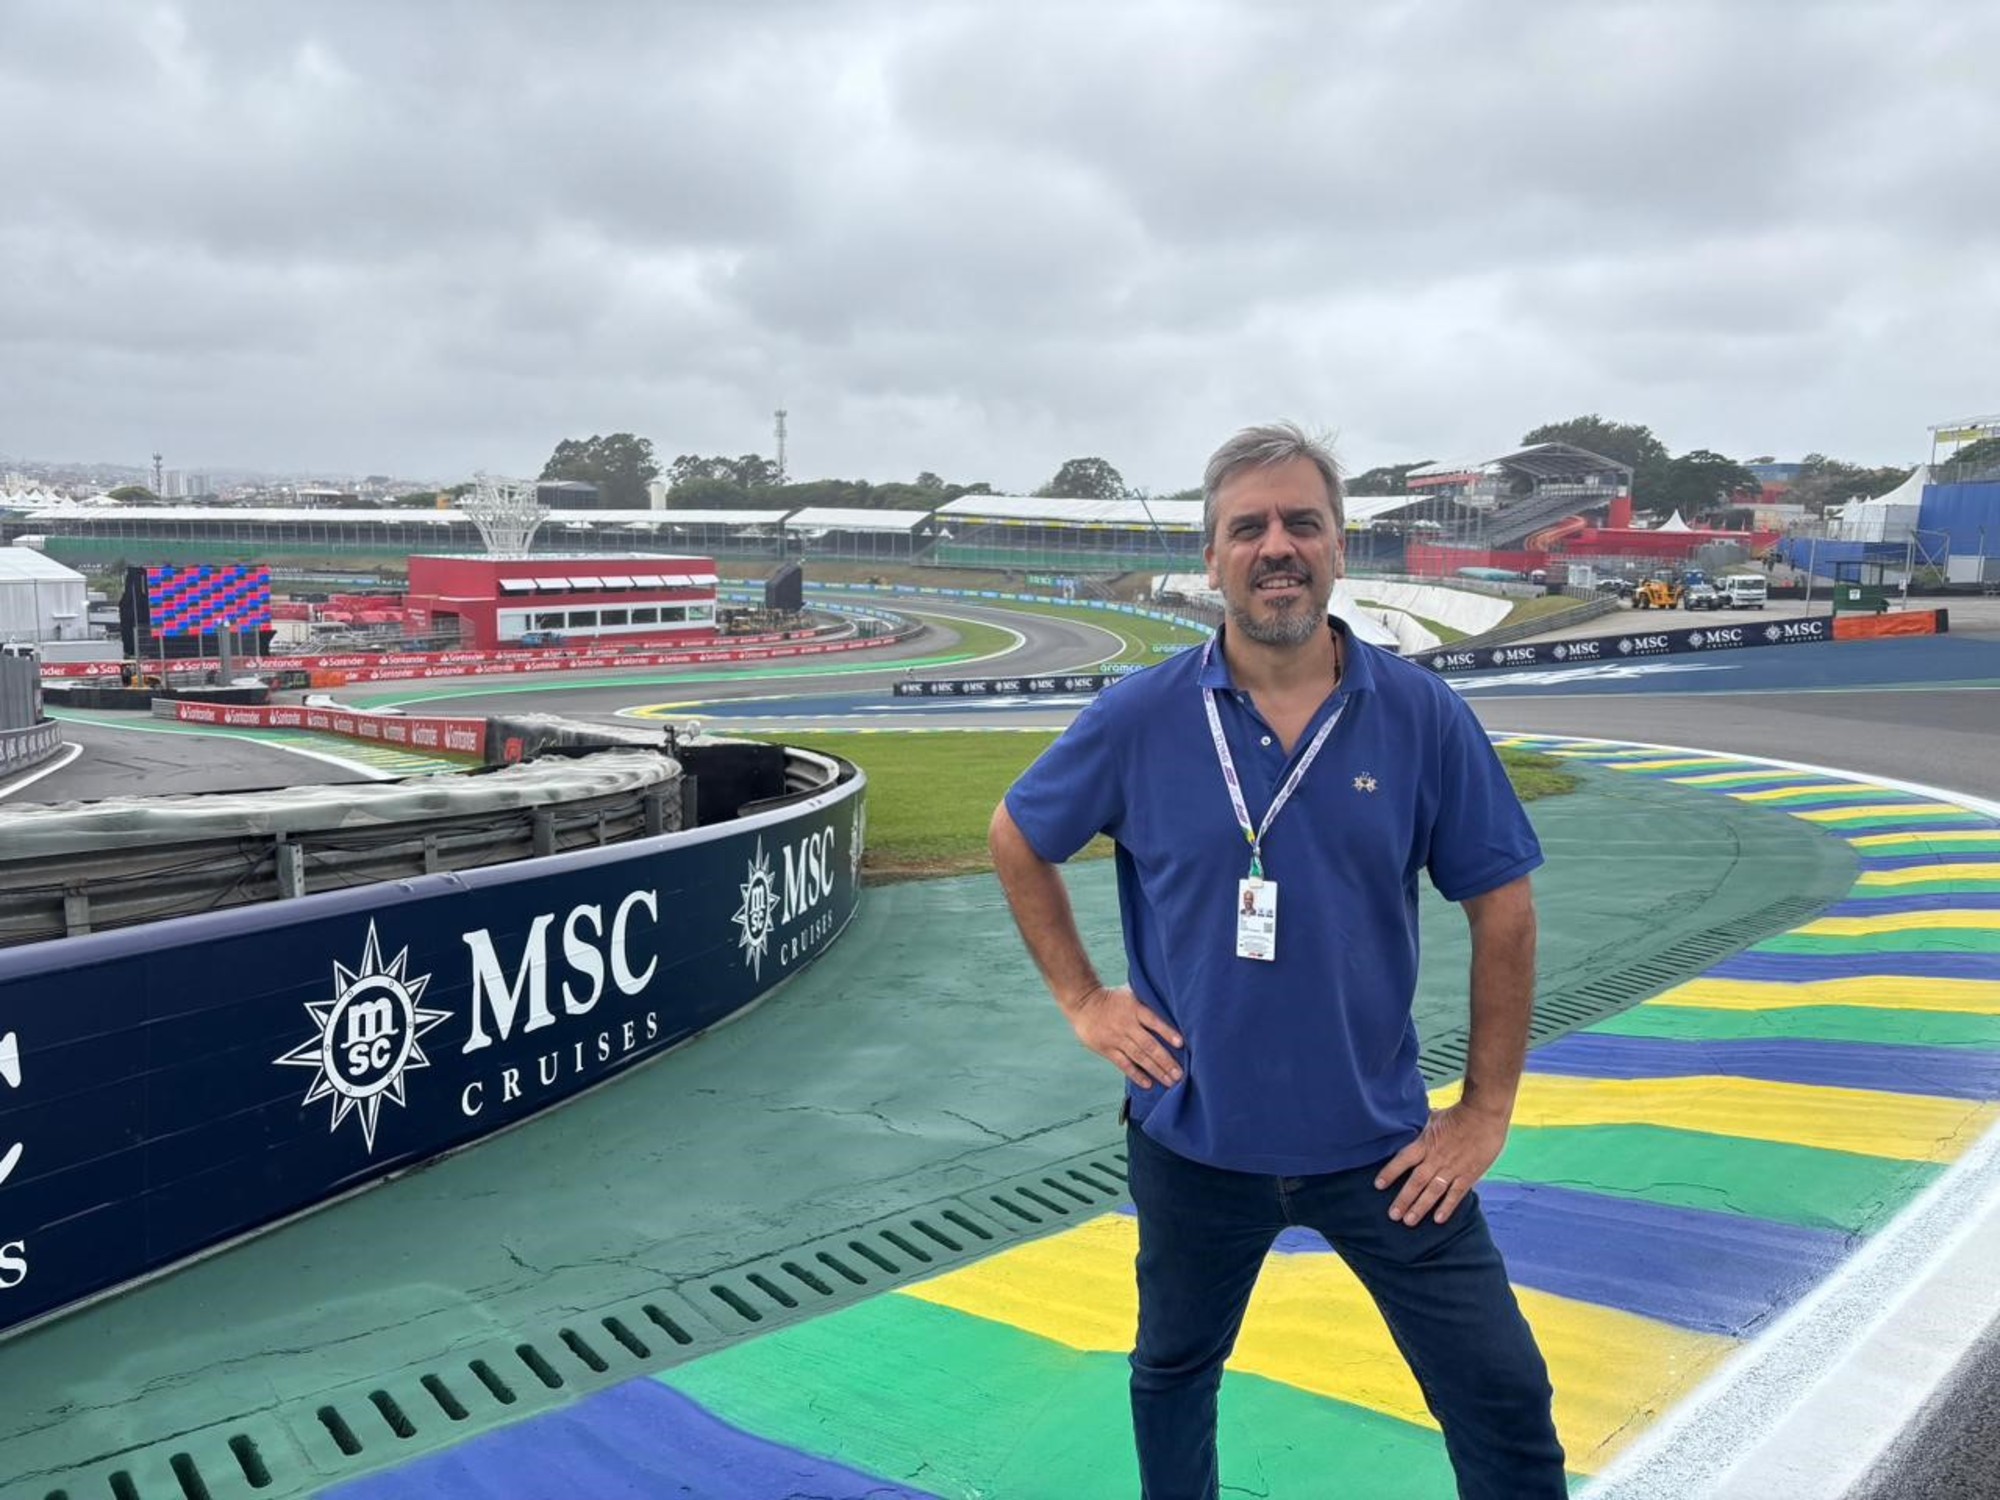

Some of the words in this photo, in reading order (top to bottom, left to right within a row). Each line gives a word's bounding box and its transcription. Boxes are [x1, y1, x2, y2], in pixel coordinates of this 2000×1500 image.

[1706, 629, 1742, 642] MSC
[1784, 621, 1822, 636] MSC
[1569, 642, 1599, 655] MSC
[1635, 636, 1668, 649] MSC
[1447, 653, 1475, 665] MSC
[1507, 648, 1535, 660] MSC
[781, 825, 834, 925] MSC
[781, 909, 833, 966] CRUISES
[462, 889, 658, 1054] MSC
[461, 1012, 658, 1116] CRUISES
